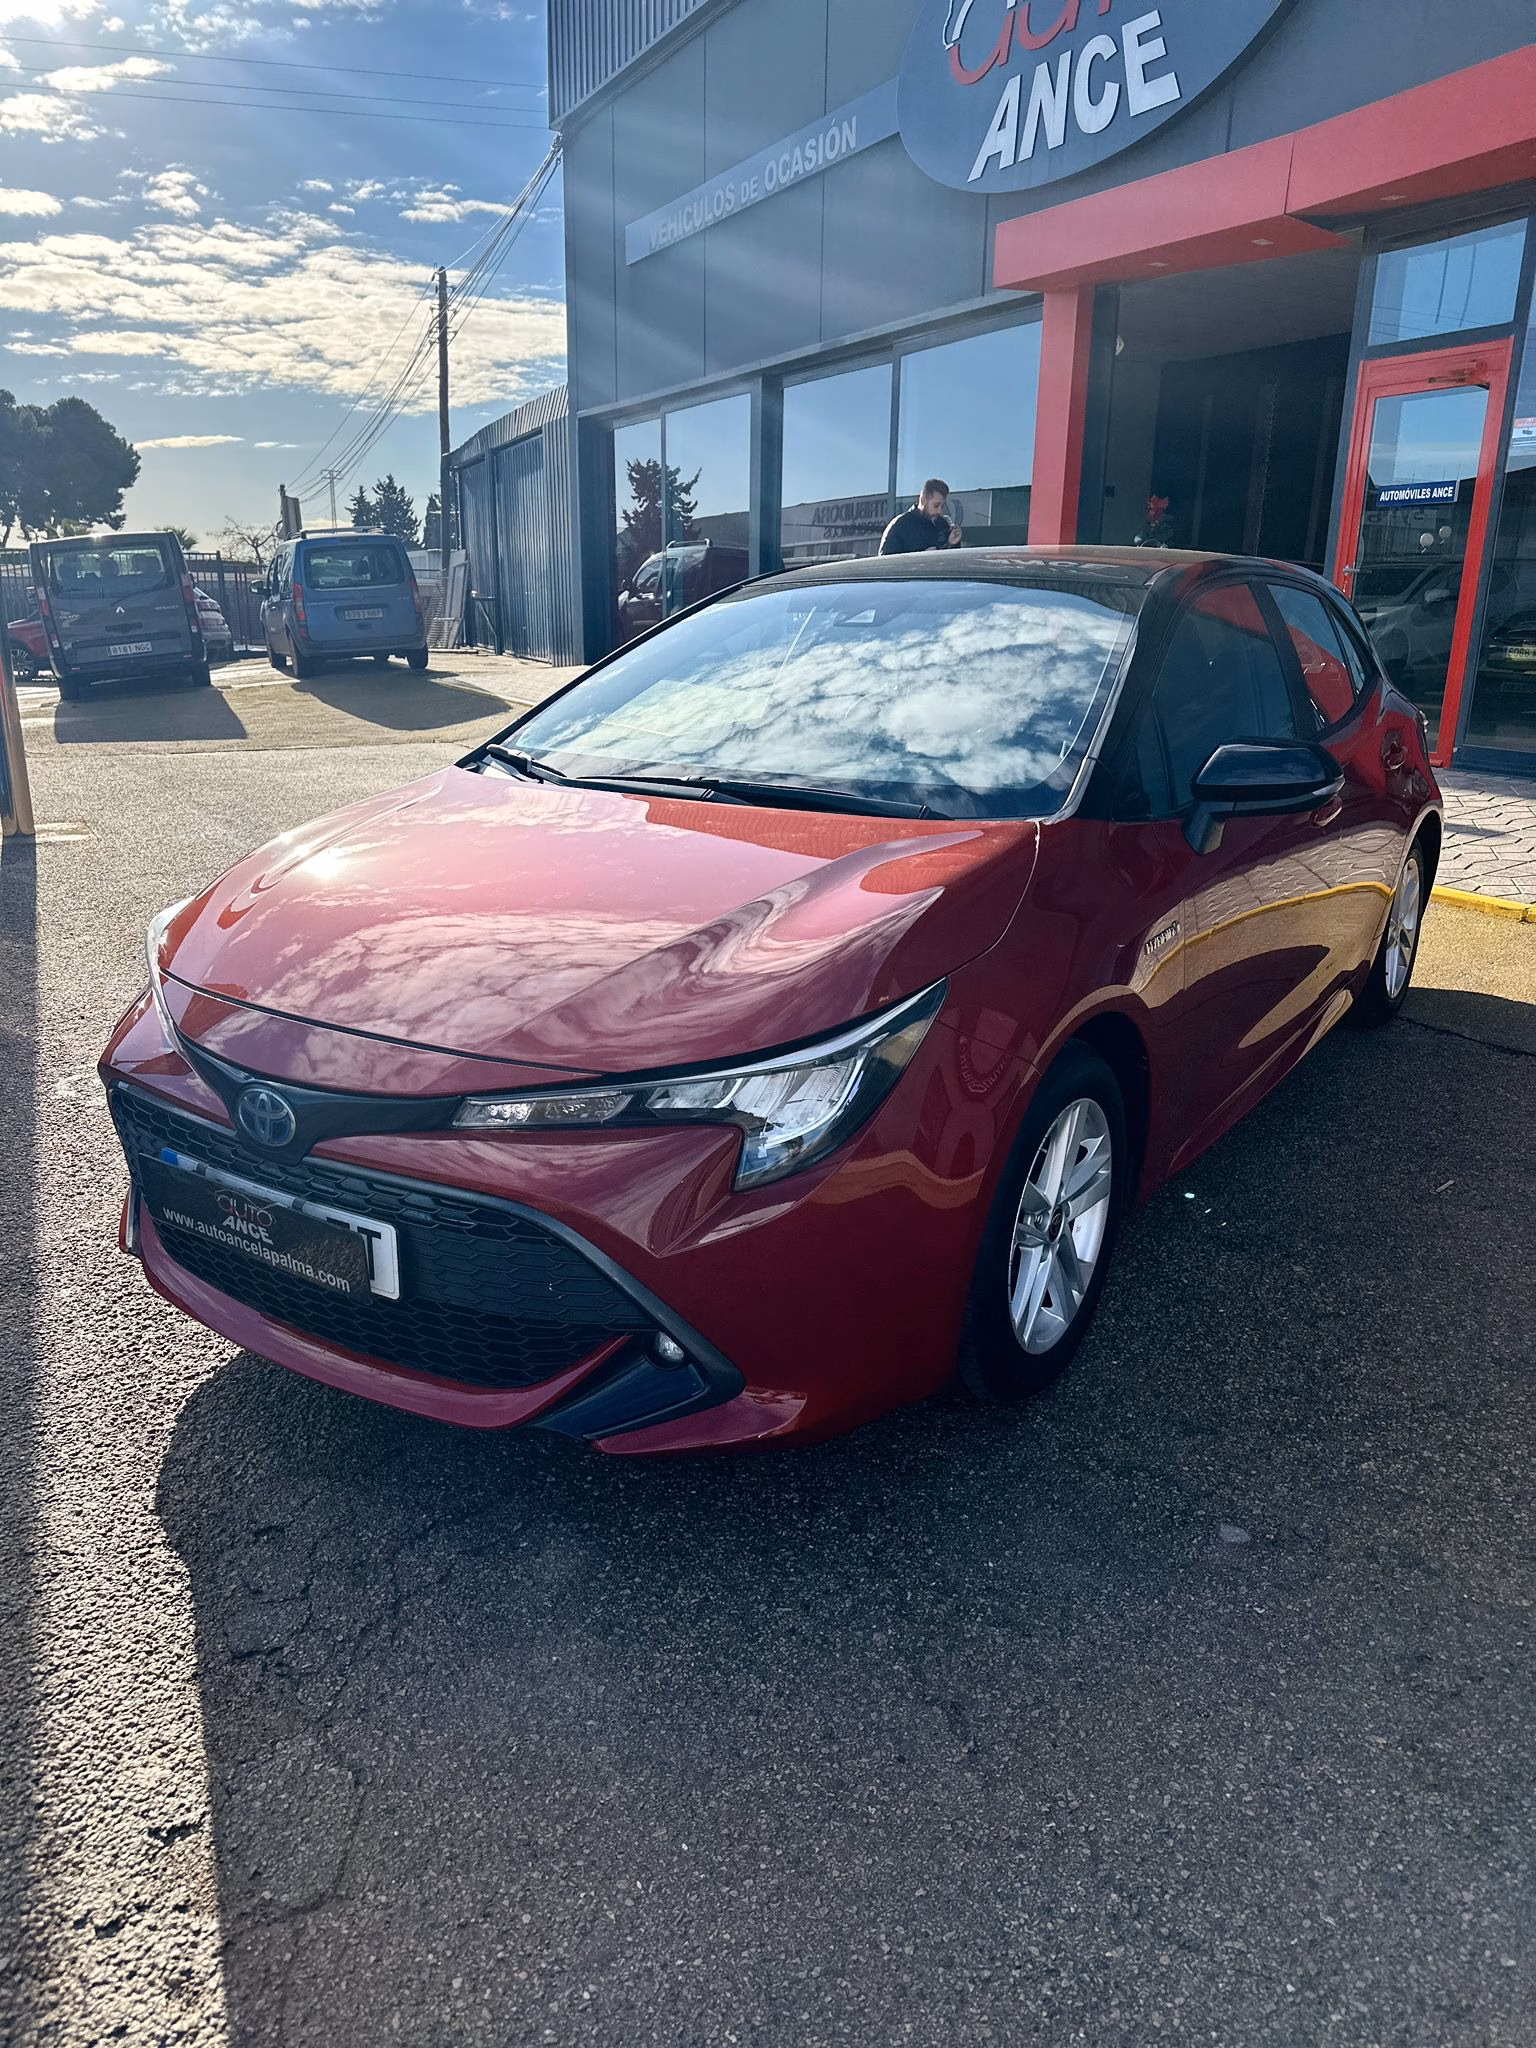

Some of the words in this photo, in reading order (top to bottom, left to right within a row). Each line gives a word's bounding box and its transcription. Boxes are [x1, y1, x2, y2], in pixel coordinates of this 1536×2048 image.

[967, 9, 1181, 183] ANCE
[740, 175, 758, 204] DE
[763, 115, 858, 191] OCASIÓN
[1379, 487, 1431, 502] AUTOMÓVILES
[1431, 486, 1454, 499] ANCE
[134, 643, 151, 653] NGC
[163, 1207, 351, 1293] www.autoancelapalma.com
[222, 1215, 274, 1245] ANCE
